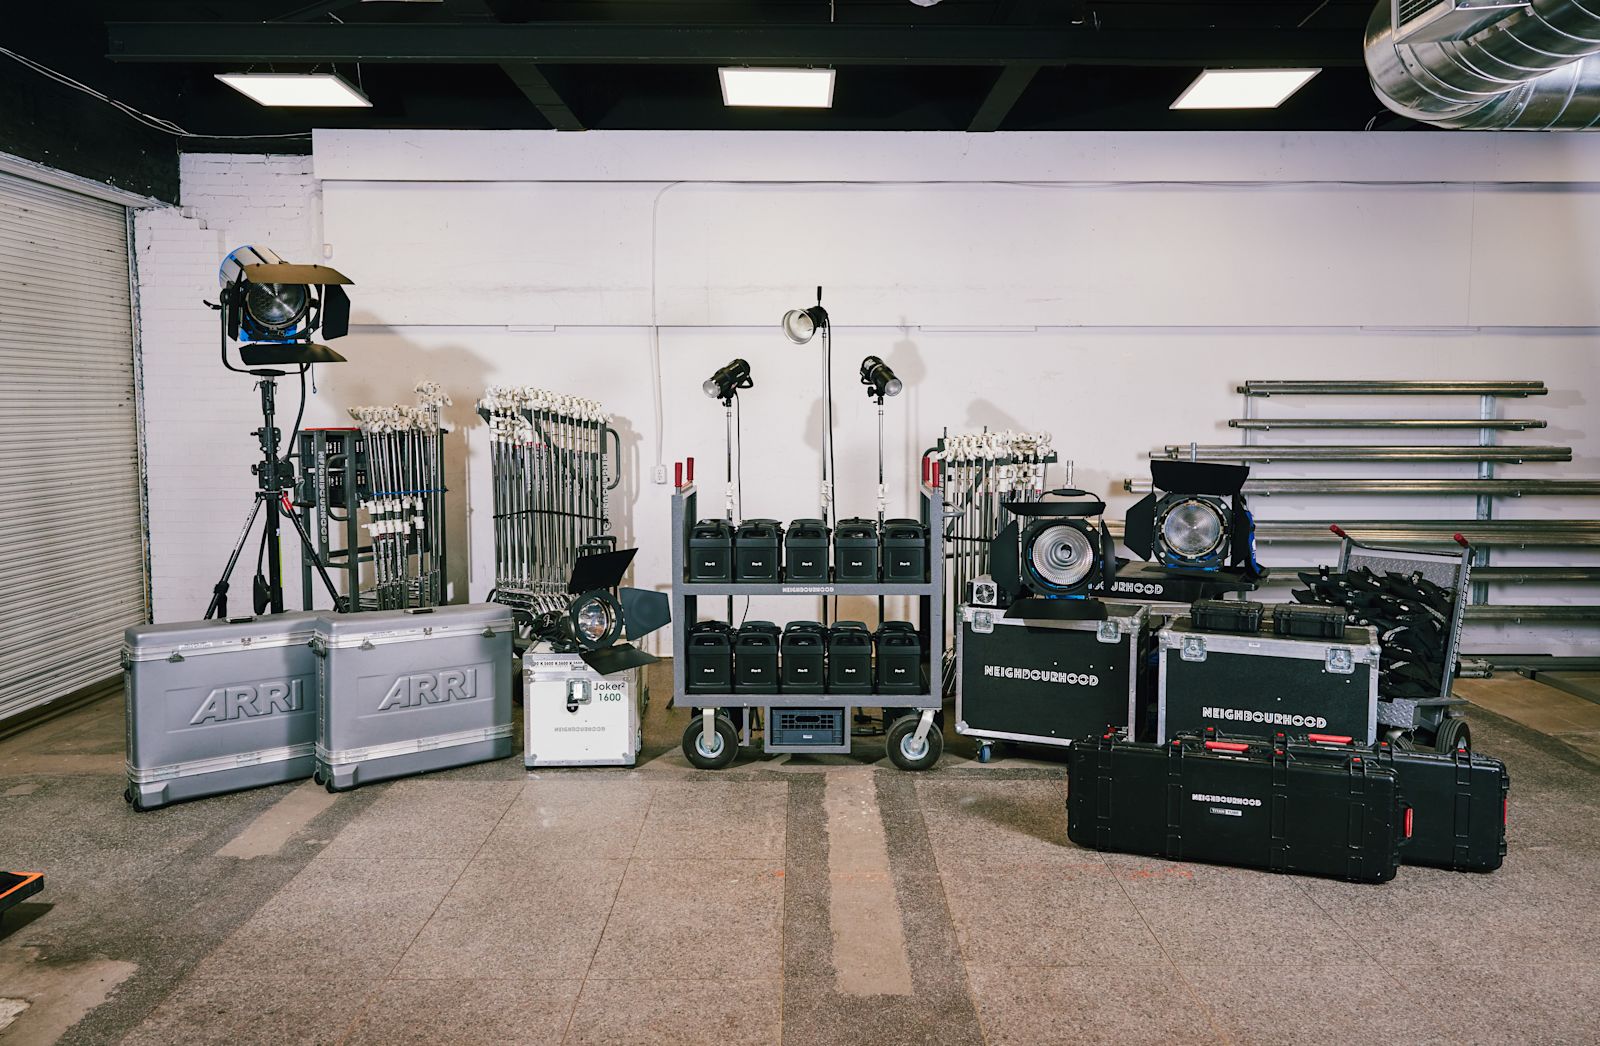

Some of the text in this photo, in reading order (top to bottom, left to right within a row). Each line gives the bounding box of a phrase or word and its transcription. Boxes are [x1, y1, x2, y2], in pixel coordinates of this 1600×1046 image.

[984, 665, 1099, 687] NEIGHBOURHOOD
[378, 667, 477, 710] ARRI
[599, 693, 621, 703] 1600
[190, 678, 304, 725] ARRI
[1202, 707, 1328, 729] NEIGHBOURHOOD
[1191, 793, 1262, 806] NEIGHBOURHOOD
